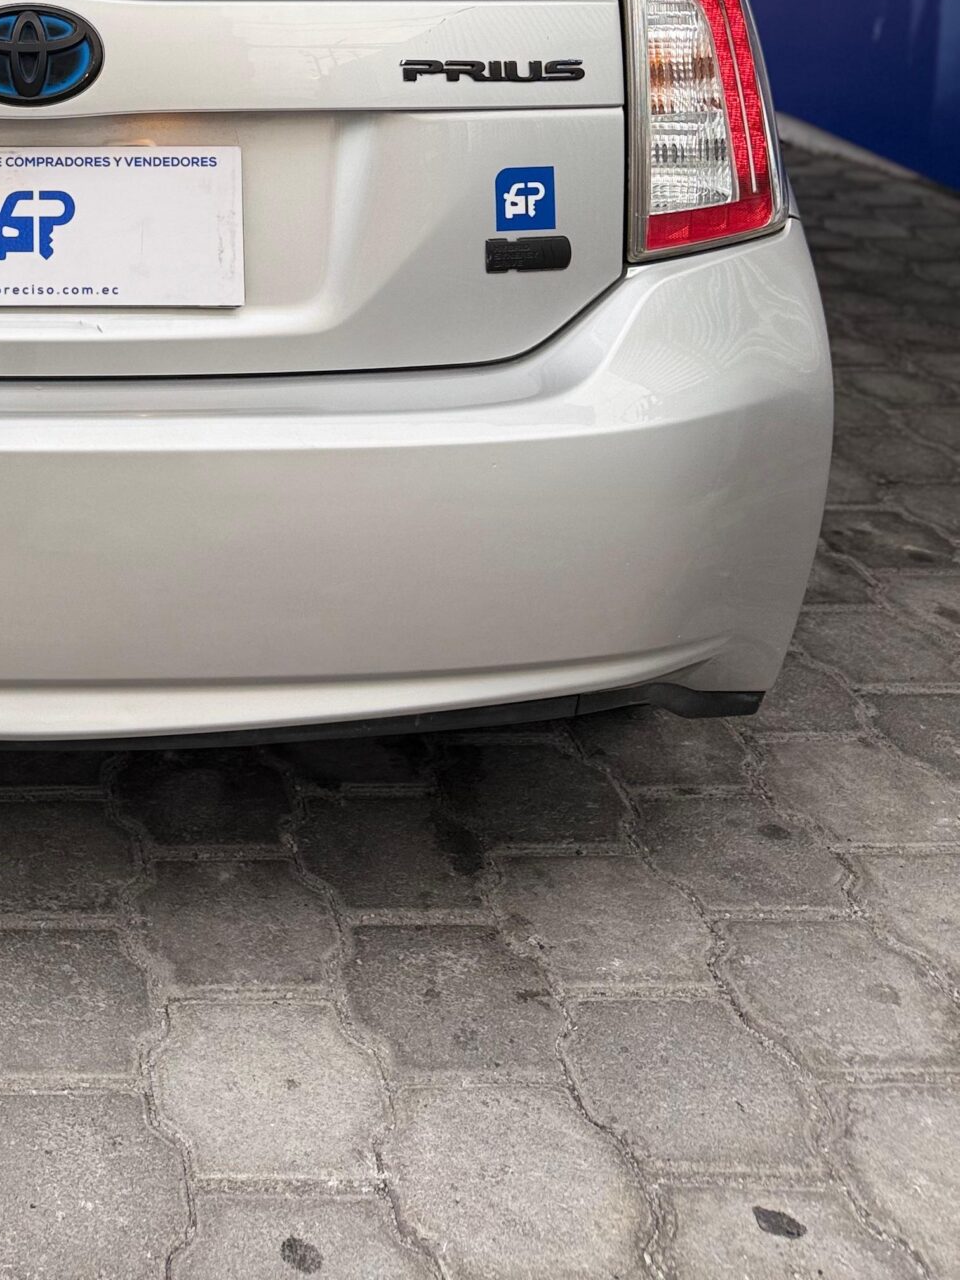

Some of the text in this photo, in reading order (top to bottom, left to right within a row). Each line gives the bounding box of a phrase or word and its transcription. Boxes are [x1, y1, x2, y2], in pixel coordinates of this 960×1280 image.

[399, 59, 586, 82] PRIUS
[5, 156, 111, 168] COMPRADORES
[113, 156, 123, 168] Y
[124, 156, 218, 168] VENDEDORES
